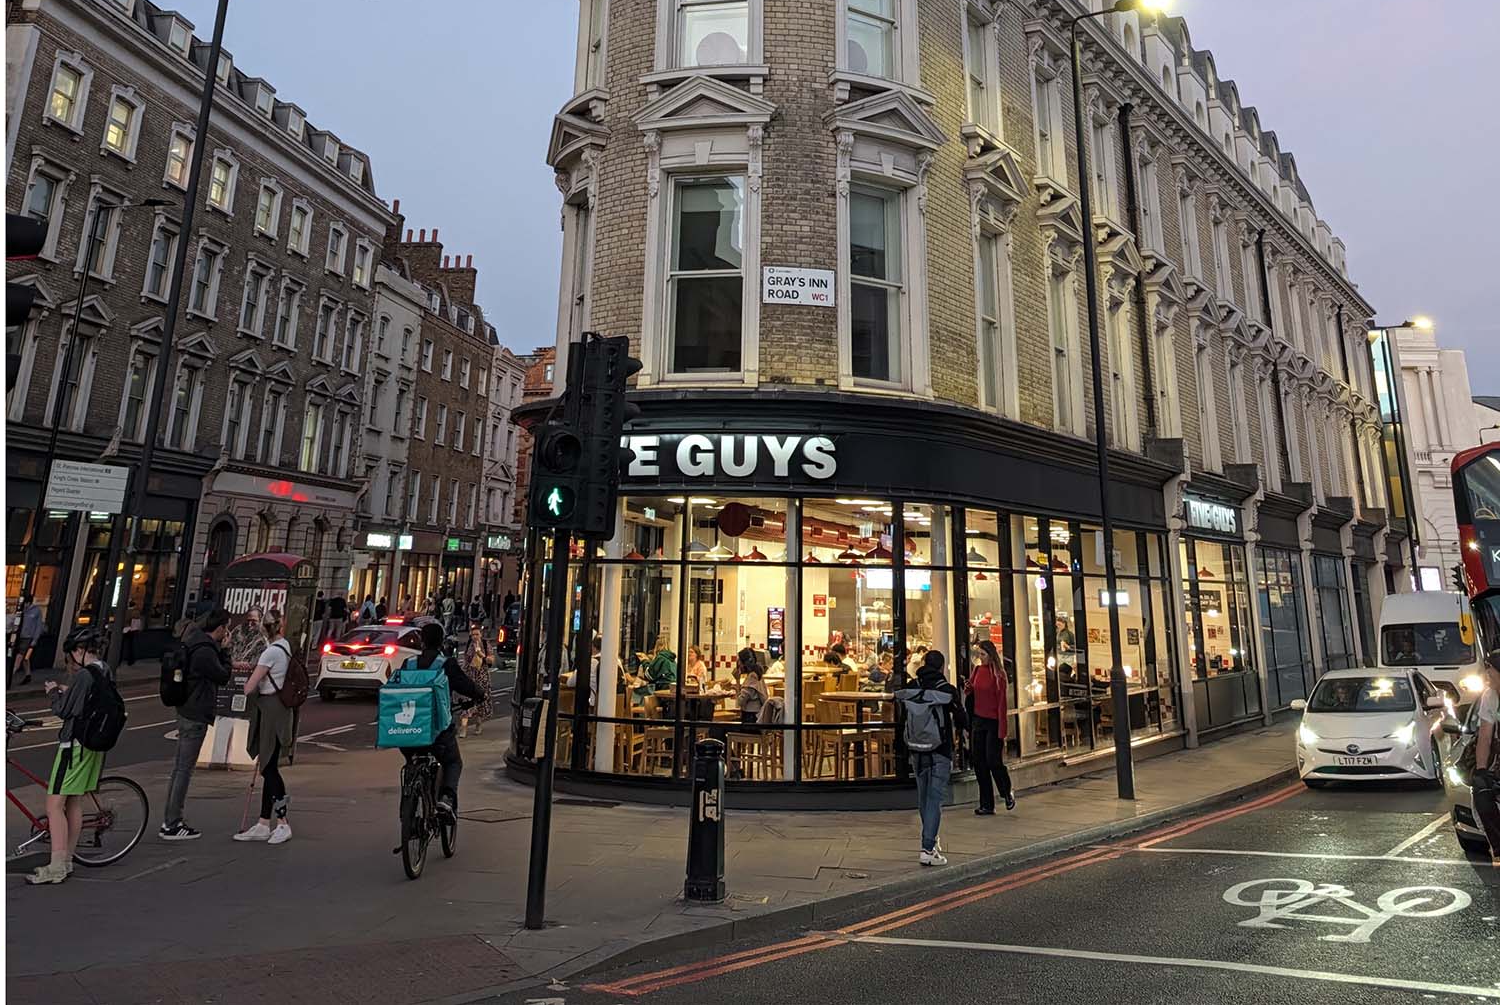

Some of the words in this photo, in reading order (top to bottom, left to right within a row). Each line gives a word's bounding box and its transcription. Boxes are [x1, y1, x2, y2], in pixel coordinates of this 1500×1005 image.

[767, 276, 806, 287] GRAY'S
[808, 278, 828, 289] INN
[767, 289, 800, 299] ROAD
[811, 293, 829, 301] WC1
[676, 434, 837, 479] GUYS
[1190, 500, 1212, 529] FIVE
[1212, 505, 1237, 534] GUYS
[387, 727, 422, 735] deliveroo
